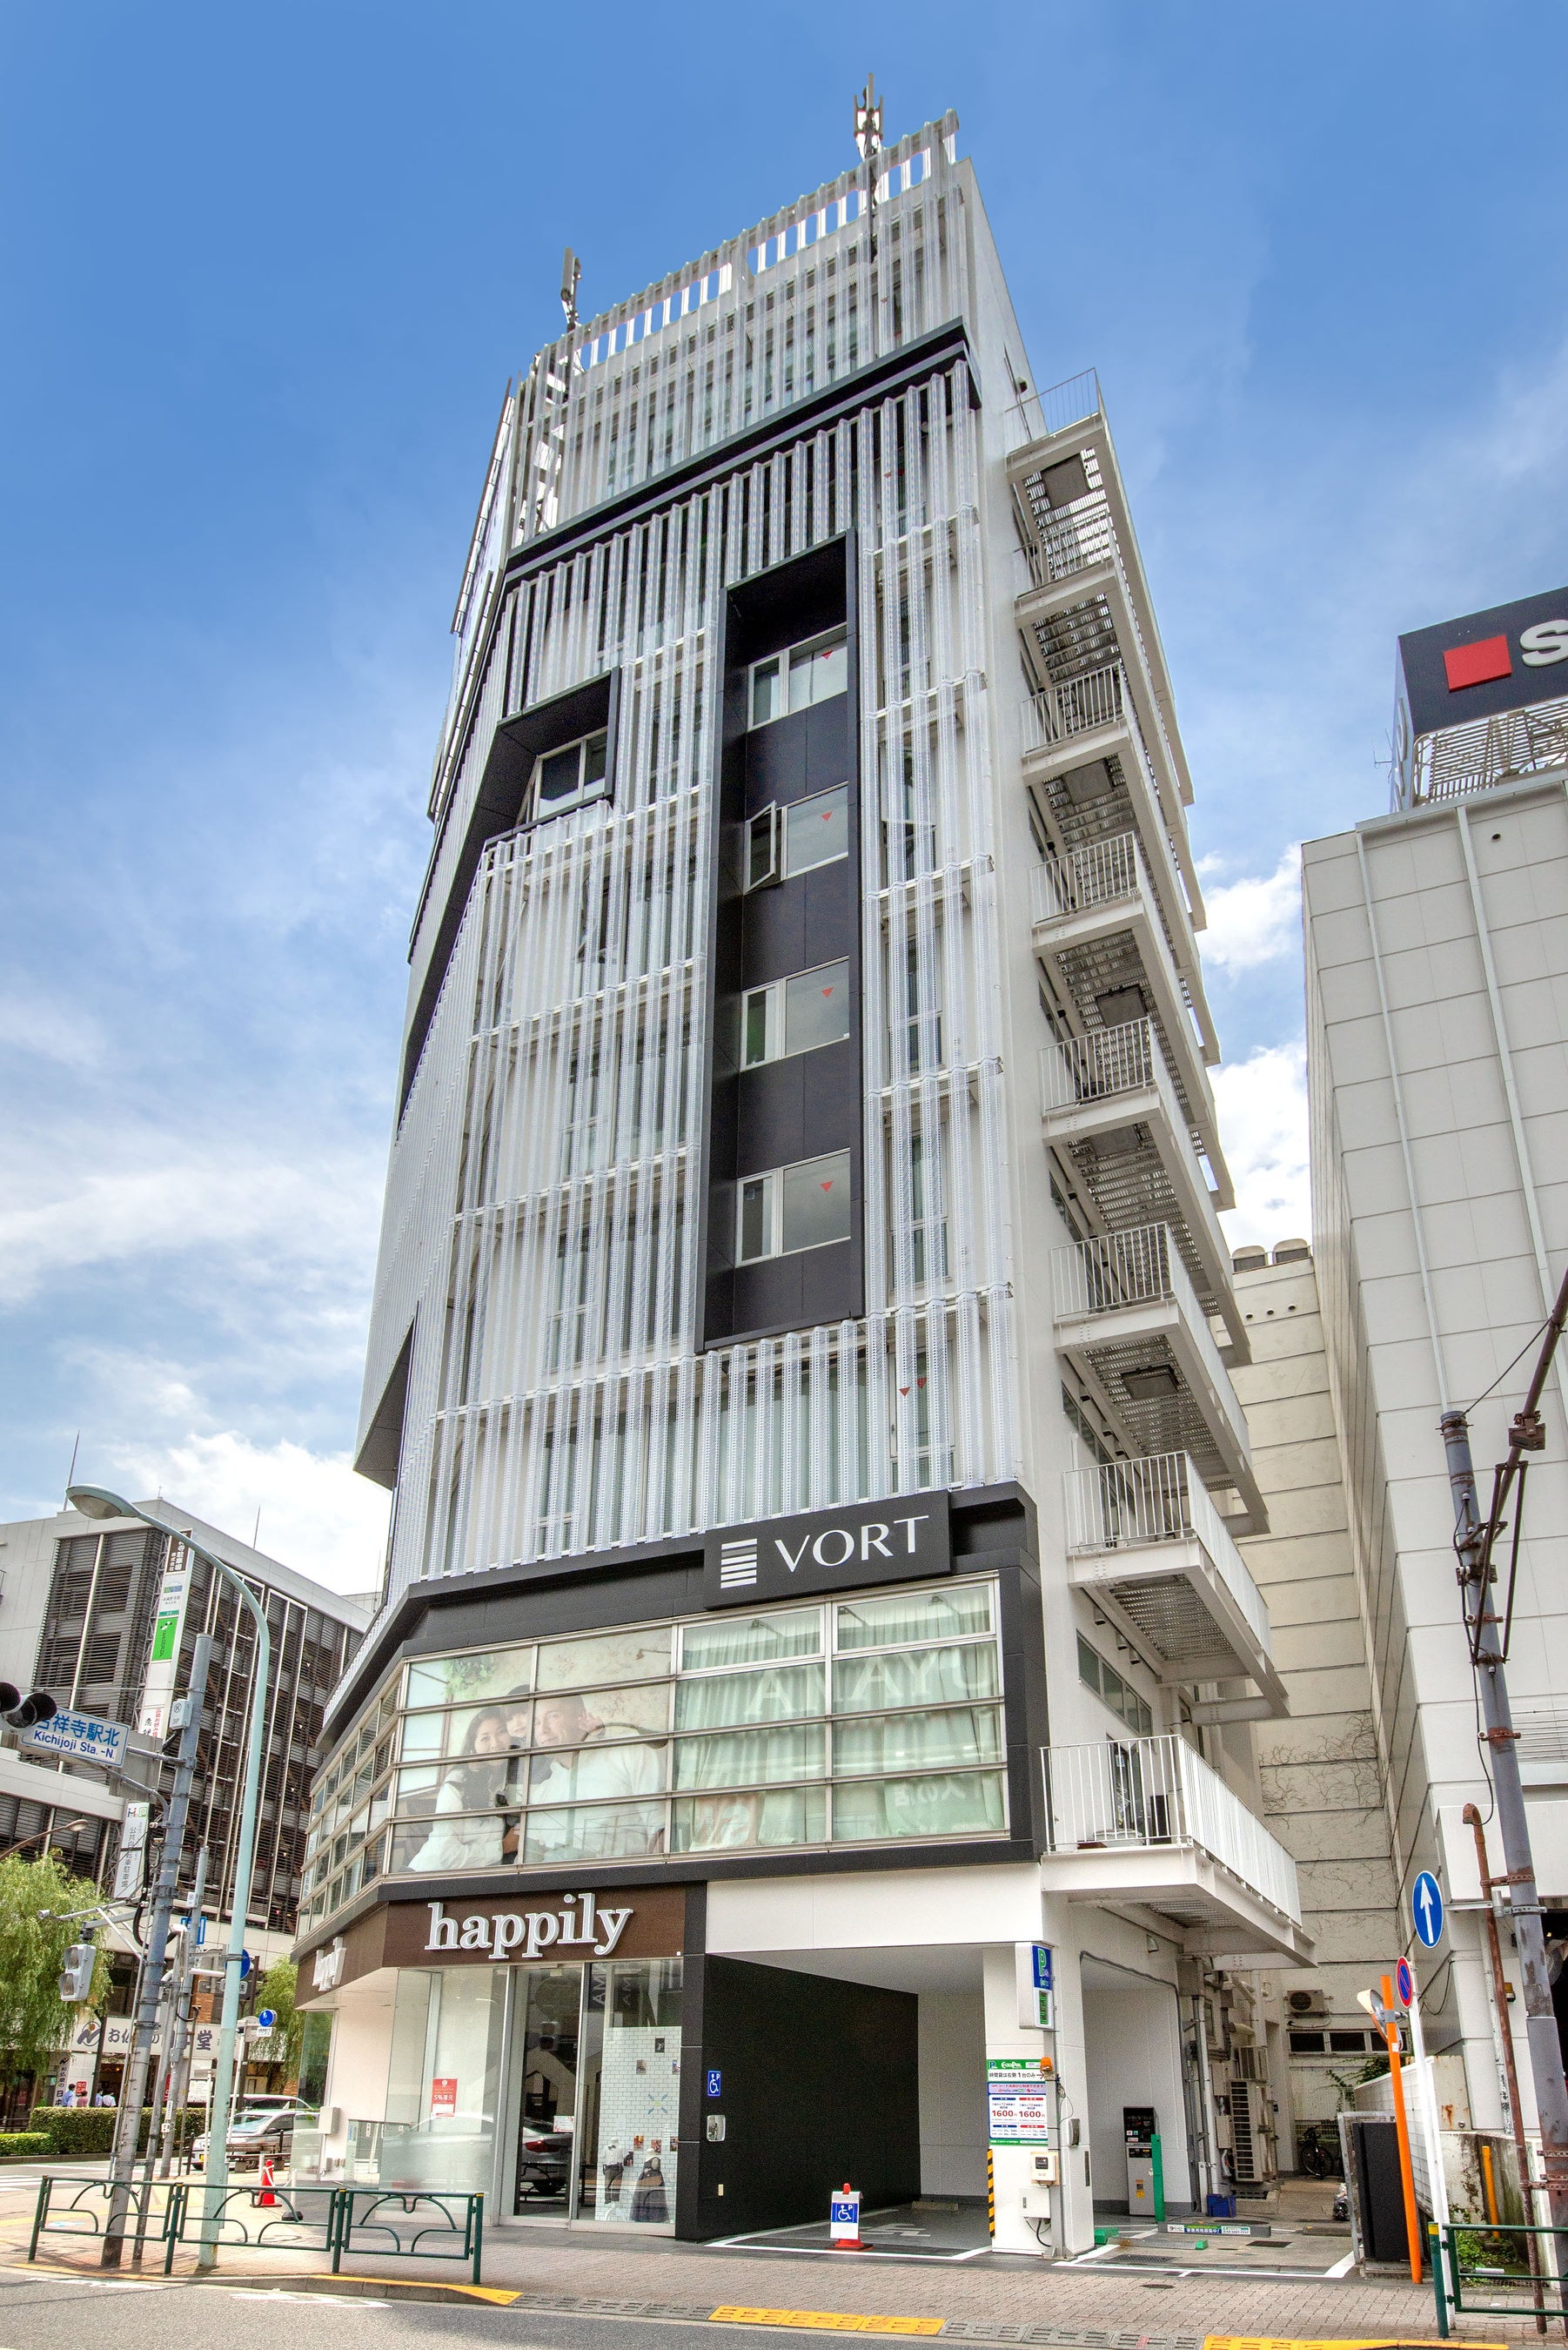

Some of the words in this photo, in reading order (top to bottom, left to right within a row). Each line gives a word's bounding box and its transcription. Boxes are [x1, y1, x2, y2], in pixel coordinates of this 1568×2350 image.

[774, 1514, 929, 1573] VORT
[34, 1729, 77, 1750] Kichijoji
[80, 1742, 98, 1755] Sta.
[425, 1892, 633, 1959] happily
[1038, 1948, 1047, 1977] P
